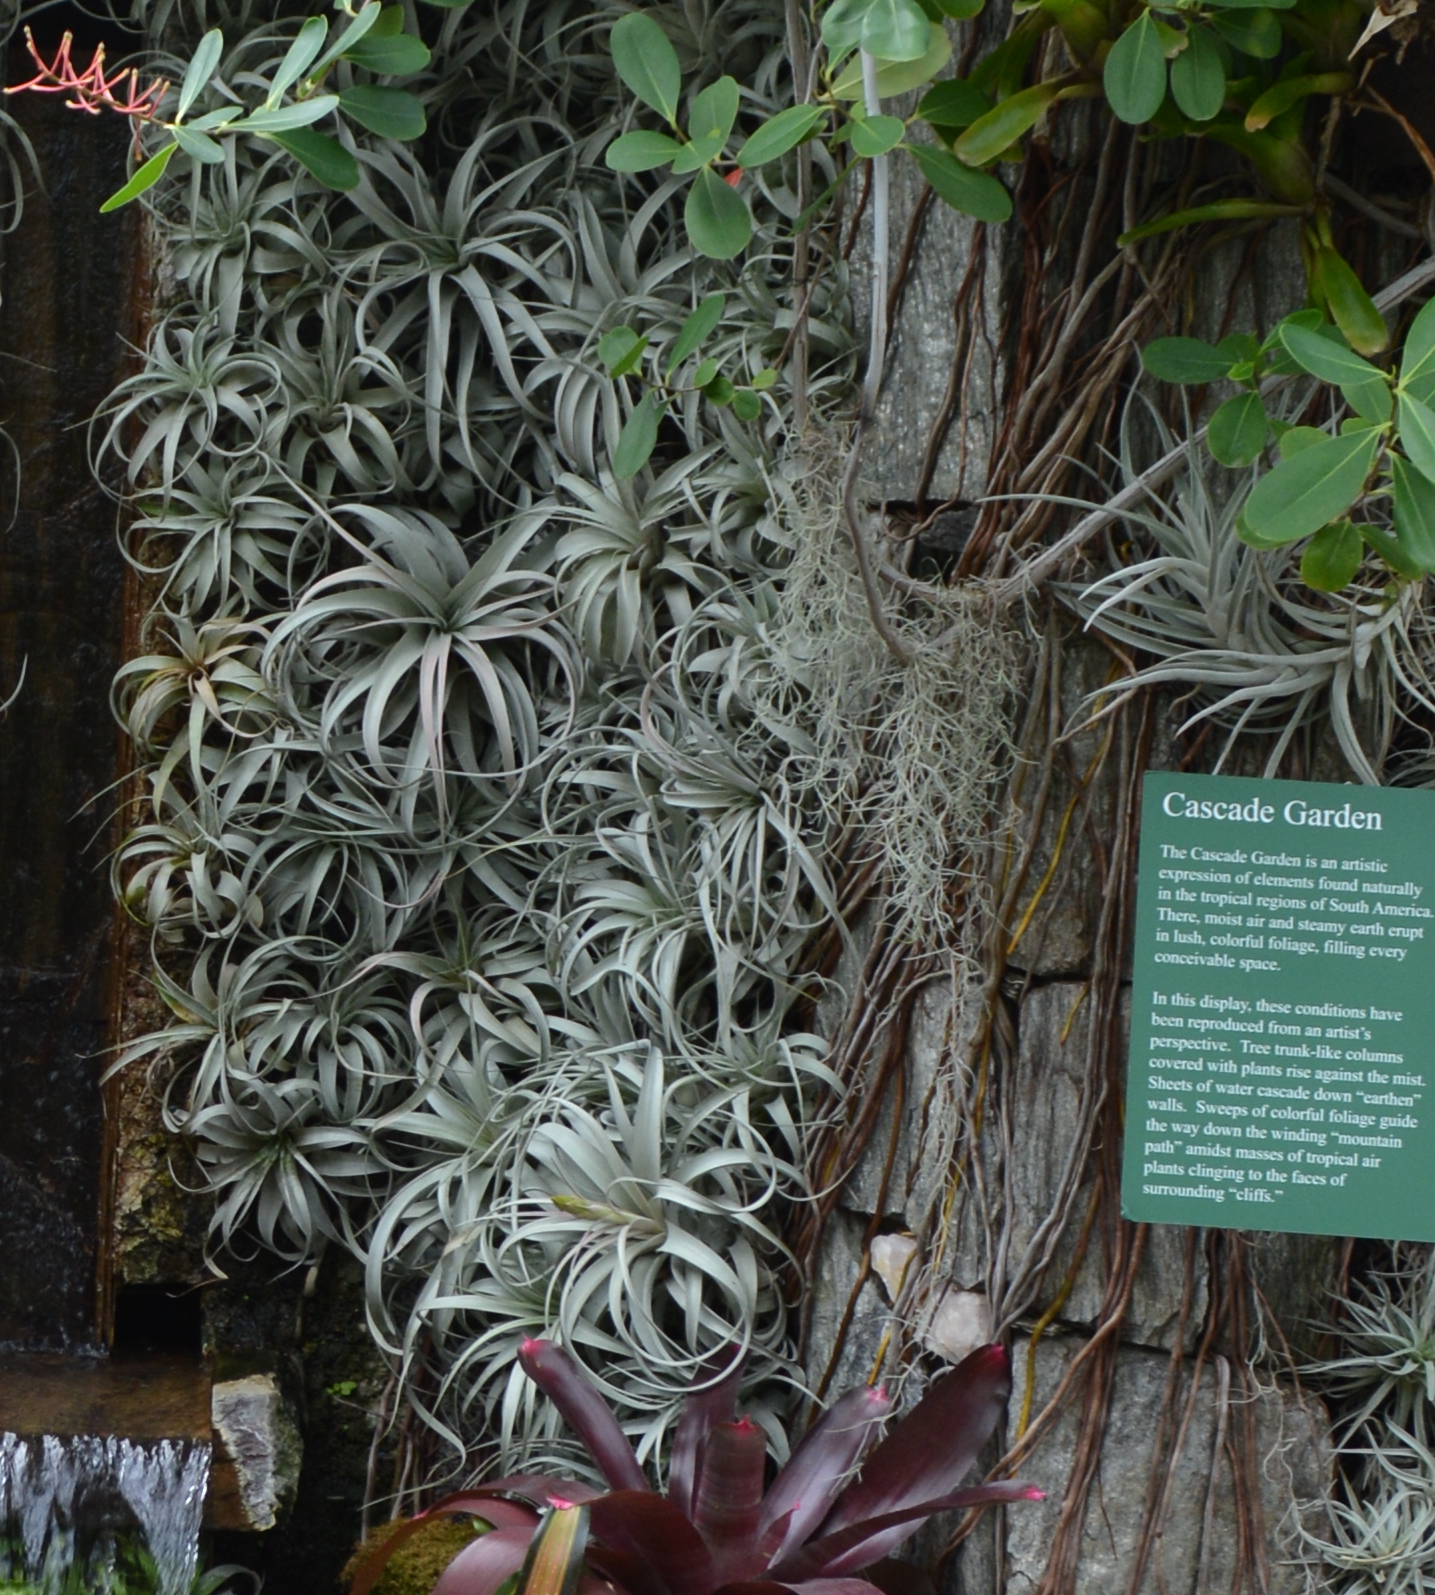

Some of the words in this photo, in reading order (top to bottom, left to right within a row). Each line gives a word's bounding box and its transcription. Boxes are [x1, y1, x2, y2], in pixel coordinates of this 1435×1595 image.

[1162, 791, 1275, 823] Cascade
[1284, 800, 1382, 830] Garden
[1160, 844, 1187, 859] The
[1190, 847, 1248, 863] Cascade
[1251, 851, 1301, 867] Garden
[1306, 854, 1317, 868] is
[1321, 859, 1338, 869] an
[1341, 858, 1388, 873] artistic
[1158, 869, 1231, 883] expression
[1235, 871, 1252, 884] of
[1254, 873, 1314, 889] elements
[1319, 876, 1358, 892] found
[1362, 882, 1423, 899] naturally
[1158, 886, 1171, 900] in
[1175, 888, 1197, 902] the
[1201, 891, 1252, 907] tropical
[1256, 897, 1307, 911] regions
[1310, 897, 1328, 911] of
[1329, 898, 1369, 914] South
[1372, 902, 1434, 918] America.
[1157, 907, 1200, 924] There,
[1205, 914, 1242, 926] moist
[1246, 914, 1266, 927] air
[1268, 916, 1294, 929] and
[1298, 920, 1346, 936] steamy
[1350, 922, 1384, 936] earth
[1388, 927, 1424, 941] erupt
[1156, 928, 1169, 942] in
[1174, 929, 1206, 945] lush,
[1210, 933, 1264, 949] colorful
[1268, 936, 1319, 955] foliage,
[1324, 940, 1366, 959] filling
[1369, 946, 1407, 962] every
[1154, 952, 1236, 968] conceivable
[1239, 959, 1281, 972] space.
[1153, 991, 1167, 1005] In
[1171, 992, 1196, 1007] this
[1199, 994, 1252, 1014] display,
[1256, 998, 1292, 1014] these
[1295, 1003, 1366, 1019] conditions
[1370, 1006, 1403, 1021] have
[1151, 1012, 1184, 1027] been
[1188, 1018, 1264, 1033] reproduced
[1268, 1020, 1301, 1036] from
[1304, 1026, 1322, 1037] an
[1150, 1037, 1231, 1052] perspective.
[1240, 1039, 1271, 1055] Tree
[1274, 1044, 1342, 1060] trunk-like
[1345, 1048, 1404, 1064] columns
[1148, 1058, 1203, 1071] covered
[1207, 1059, 1237, 1073] with
[1241, 1061, 1283, 1077] plants
[1286, 1064, 1312, 1079] rise
[1315, 1067, 1363, 1083] against
[1367, 1070, 1389, 1084] the
[1392, 1072, 1426, 1086] mist.
[1148, 1075, 1193, 1091] Sheets
[1196, 1079, 1214, 1093] of
[1215, 1084, 1254, 1096] water
[1257, 1086, 1311, 1100] cascade
[1314, 1087, 1352, 1103] down
[1147, 1098, 1187, 1112] walls.
[1196, 1100, 1248, 1119] Sweeps
[1251, 1104, 1269, 1118] of
[1270, 1106, 1324, 1122] colorful
[1329, 1109, 1376, 1128] foliage
[1379, 1114, 1418, 1129] guide
[1146, 1118, 1168, 1132] the
[1171, 1123, 1200, 1137] way
[1203, 1122, 1242, 1137] down
[1246, 1125, 1268, 1139] the
[1271, 1127, 1327, 1146] winding
[1185, 1143, 1232, 1158] amidst
[1235, 1148, 1284, 1161] masses
[1287, 1149, 1305, 1163] of
[1306, 1152, 1358, 1167] tropical
[1362, 1154, 1382, 1168] air
[1144, 1161, 1185, 1177] plants
[1188, 1163, 1245, 1183] clinging
[1248, 1169, 1263, 1181] to
[1266, 1168, 1288, 1183] the
[1292, 1170, 1327, 1185] faces
[1330, 1173, 1348, 1187] of
[1143, 1184, 1225, 1203] surrounding
